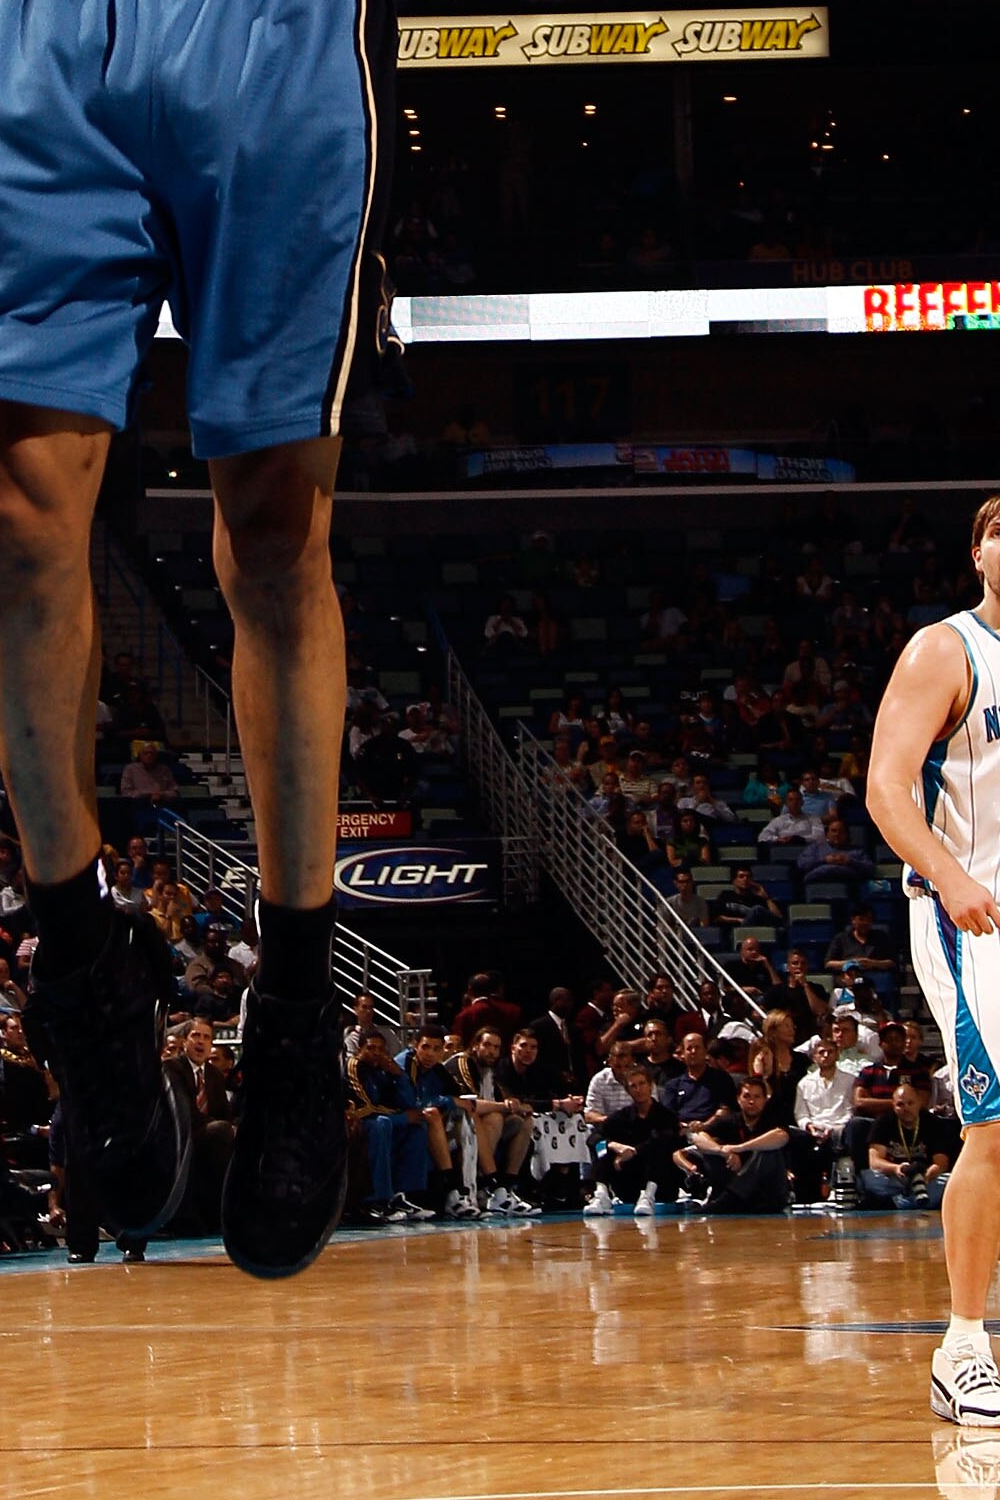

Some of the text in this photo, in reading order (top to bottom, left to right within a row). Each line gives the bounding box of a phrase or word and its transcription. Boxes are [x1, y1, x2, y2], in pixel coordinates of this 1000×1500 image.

[397, 13, 822, 61] UBWAY SUBWAY SUBWAY
[534, 376, 611, 421] 117
[340, 826, 370, 838] EXIT
[349, 864, 488, 886] LIGHT
